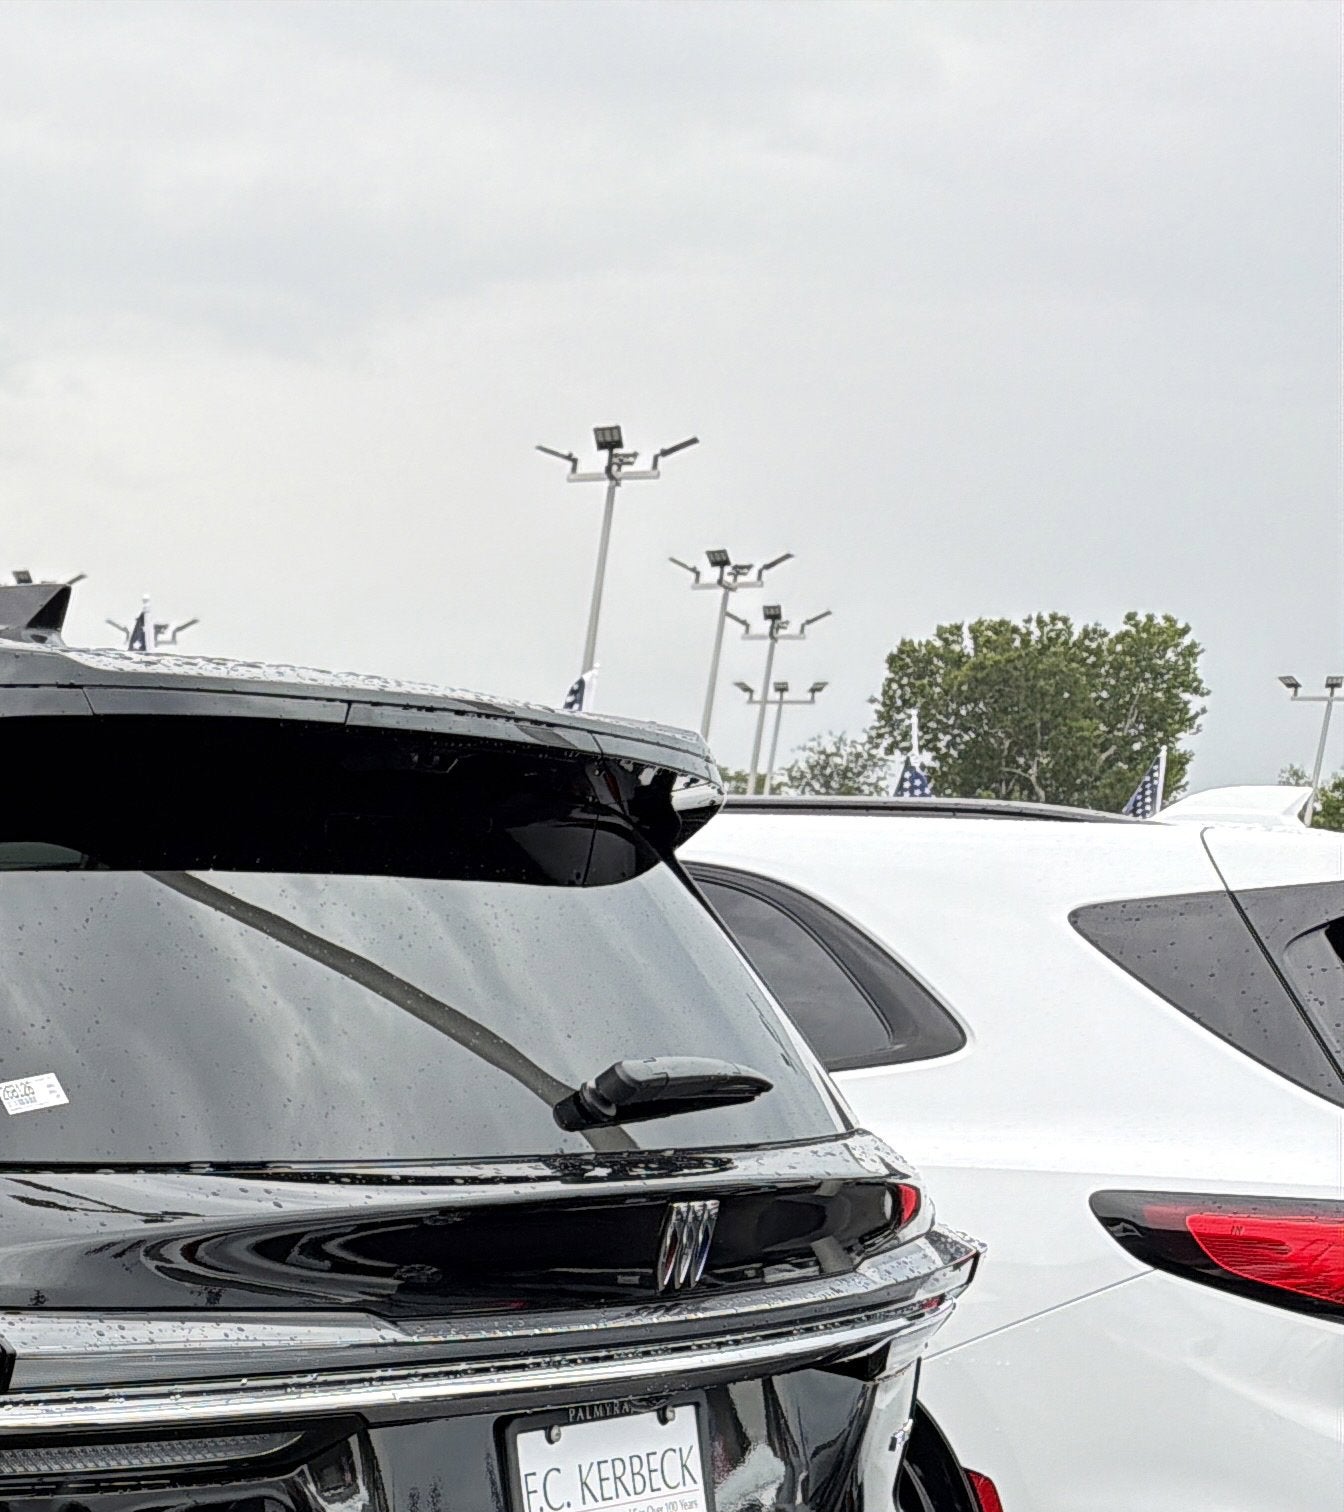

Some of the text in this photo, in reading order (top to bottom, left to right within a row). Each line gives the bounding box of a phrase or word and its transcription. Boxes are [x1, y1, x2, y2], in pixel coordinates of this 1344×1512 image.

[578, 1445, 699, 1505] KERBECK
[664, 1501, 679, 1512] 100
[679, 1498, 699, 1511] Years
